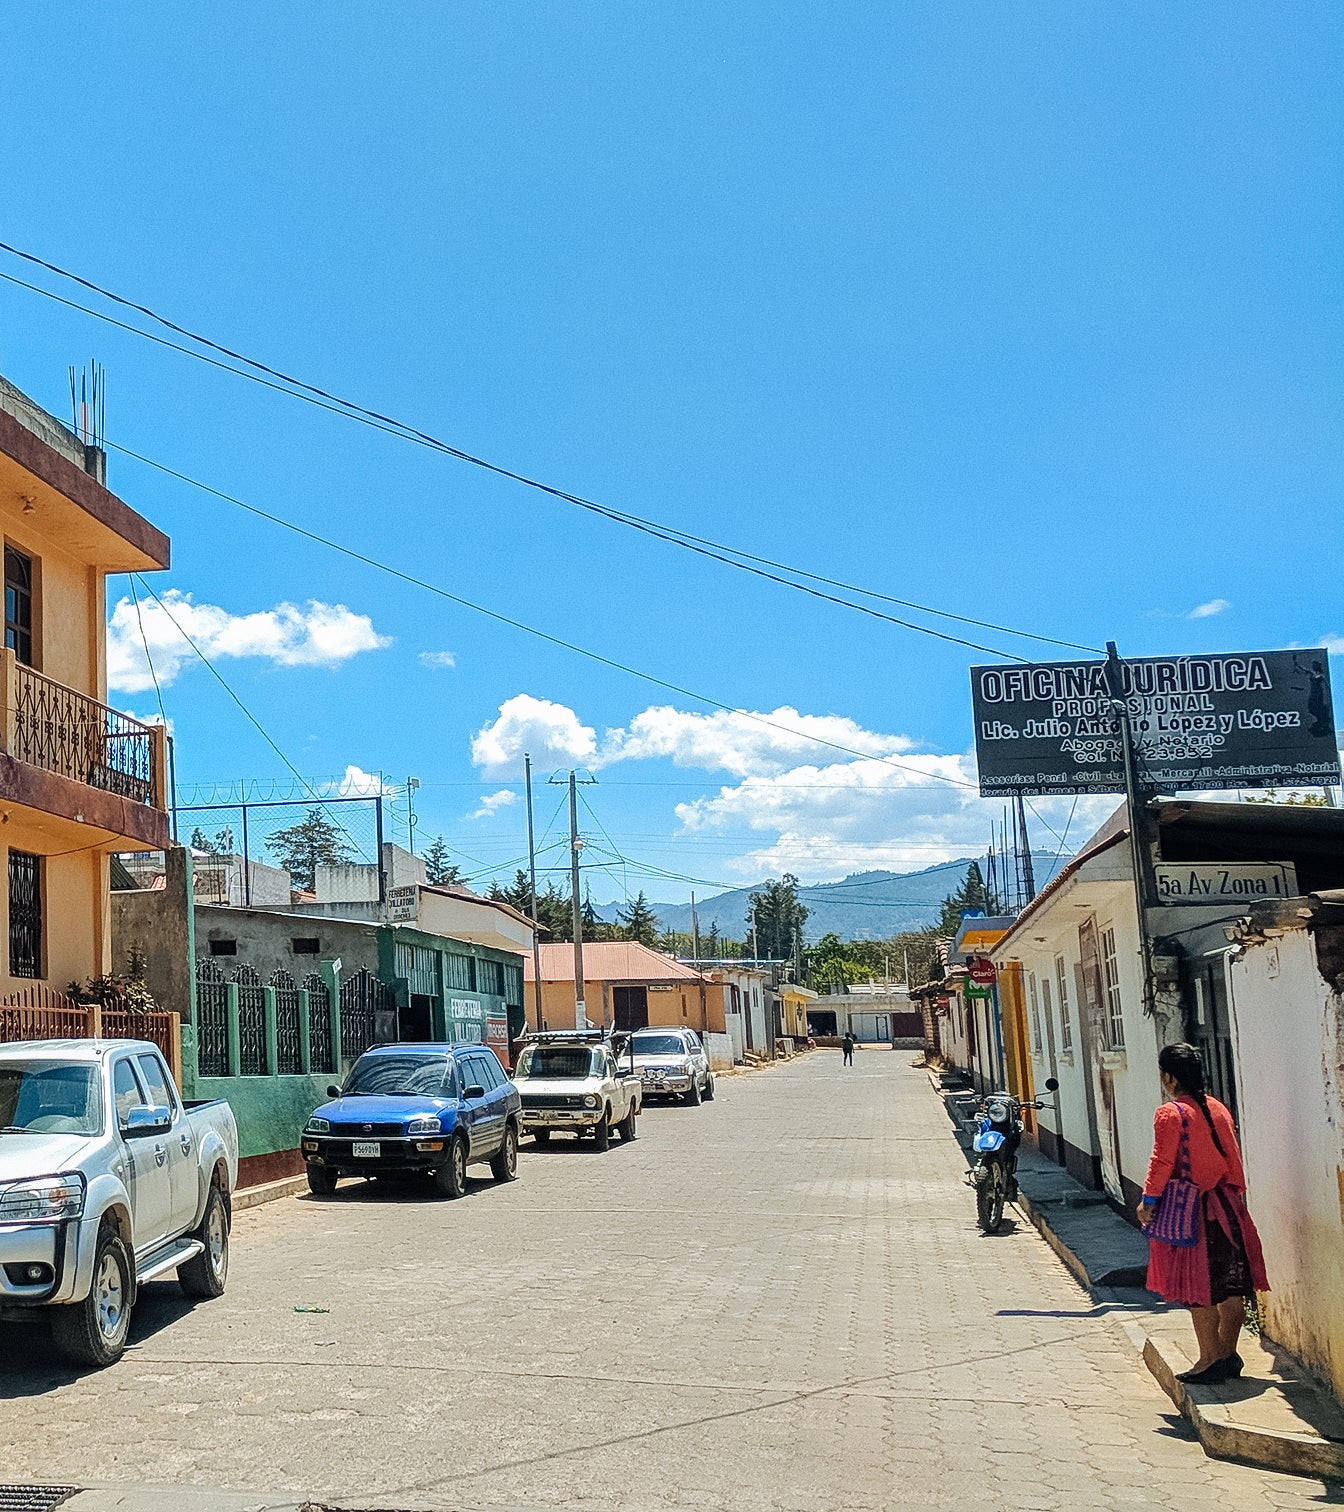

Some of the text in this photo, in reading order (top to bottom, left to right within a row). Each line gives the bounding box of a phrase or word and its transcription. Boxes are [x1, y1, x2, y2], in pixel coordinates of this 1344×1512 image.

[981, 657, 1273, 703] OFICINA JURÍDICA
[1053, 694, 1215, 718] PROFSIONAL
[981, 709, 1301, 740] Lic. Julio Antoio López y López
[1142, 738, 1153, 748] y
[1159, 733, 1226, 747] Notario
[1074, 751, 1107, 764] Col.
[1037, 772, 1067, 784] Penal
[1217, 870, 1268, 895] Zona
[1272, 874, 1282, 894] 1
